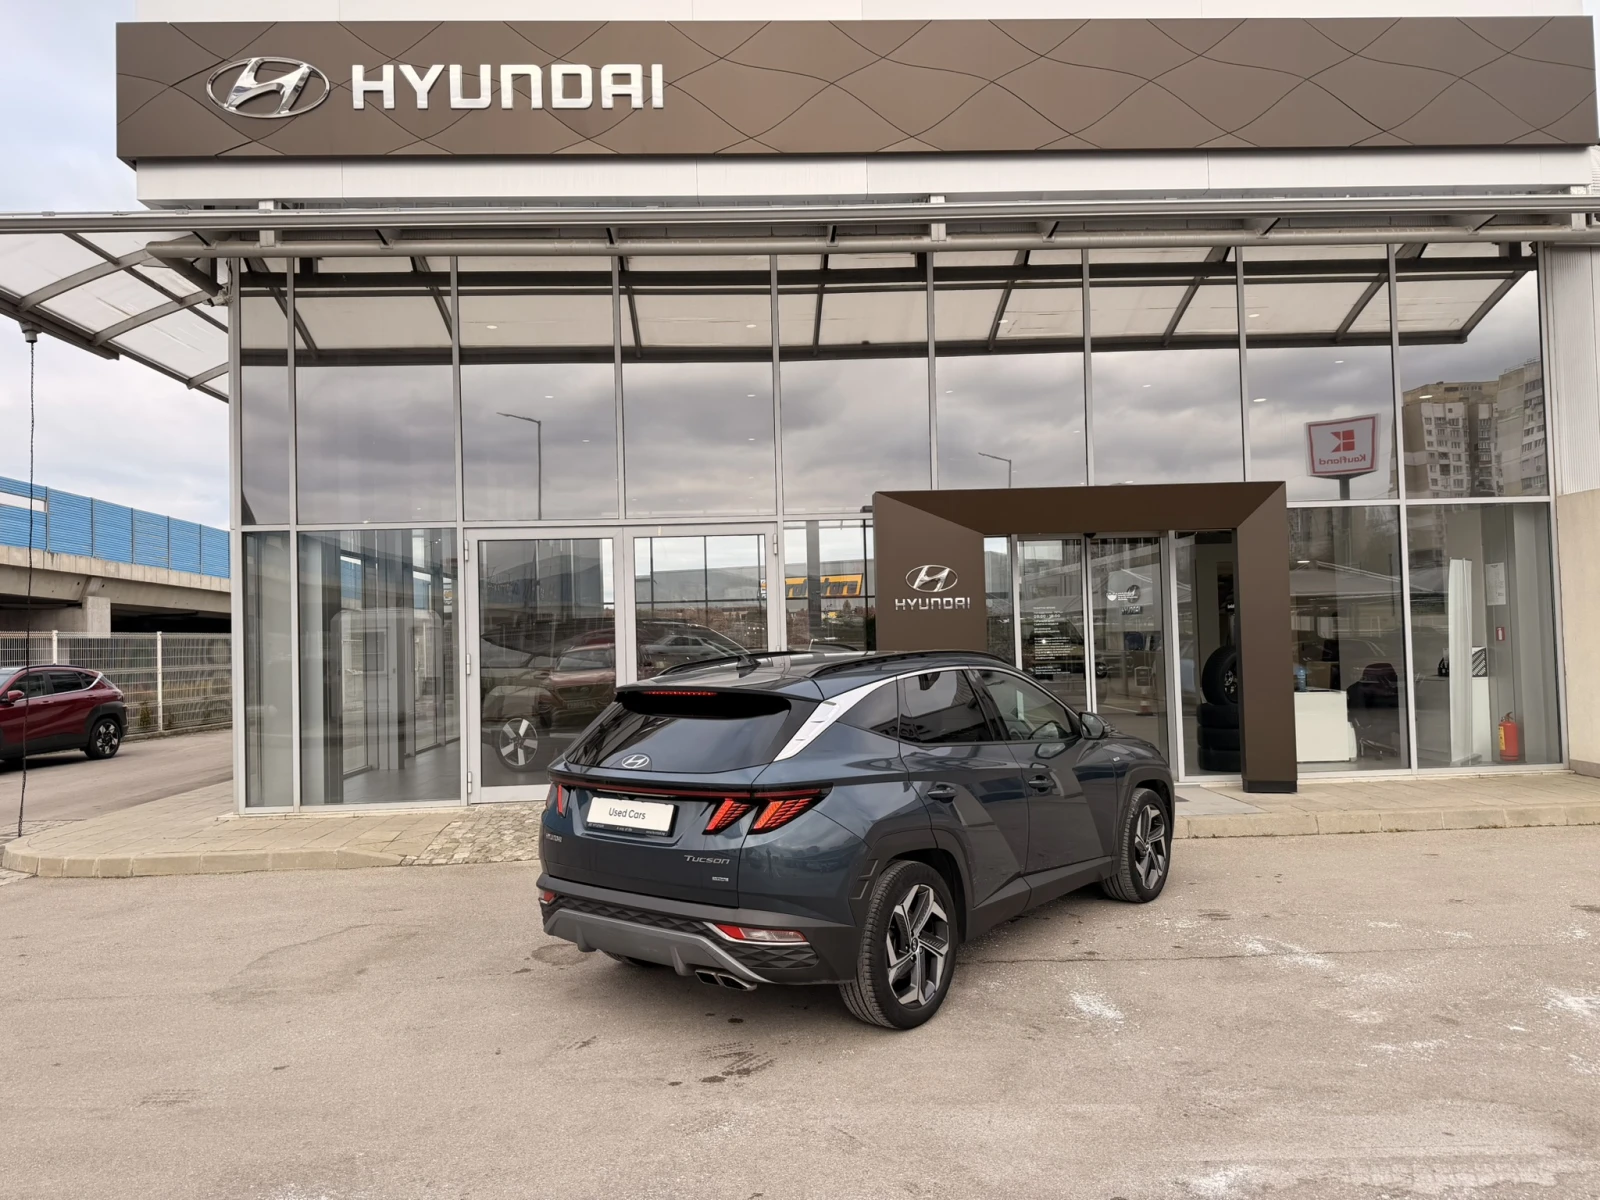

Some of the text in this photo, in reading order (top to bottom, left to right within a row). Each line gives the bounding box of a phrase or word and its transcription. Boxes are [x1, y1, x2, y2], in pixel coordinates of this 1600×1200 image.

[351, 63, 664, 110] HYUNDAI
[895, 597, 970, 611] HYUNDAI
[608, 807, 647, 819] Used Cars
